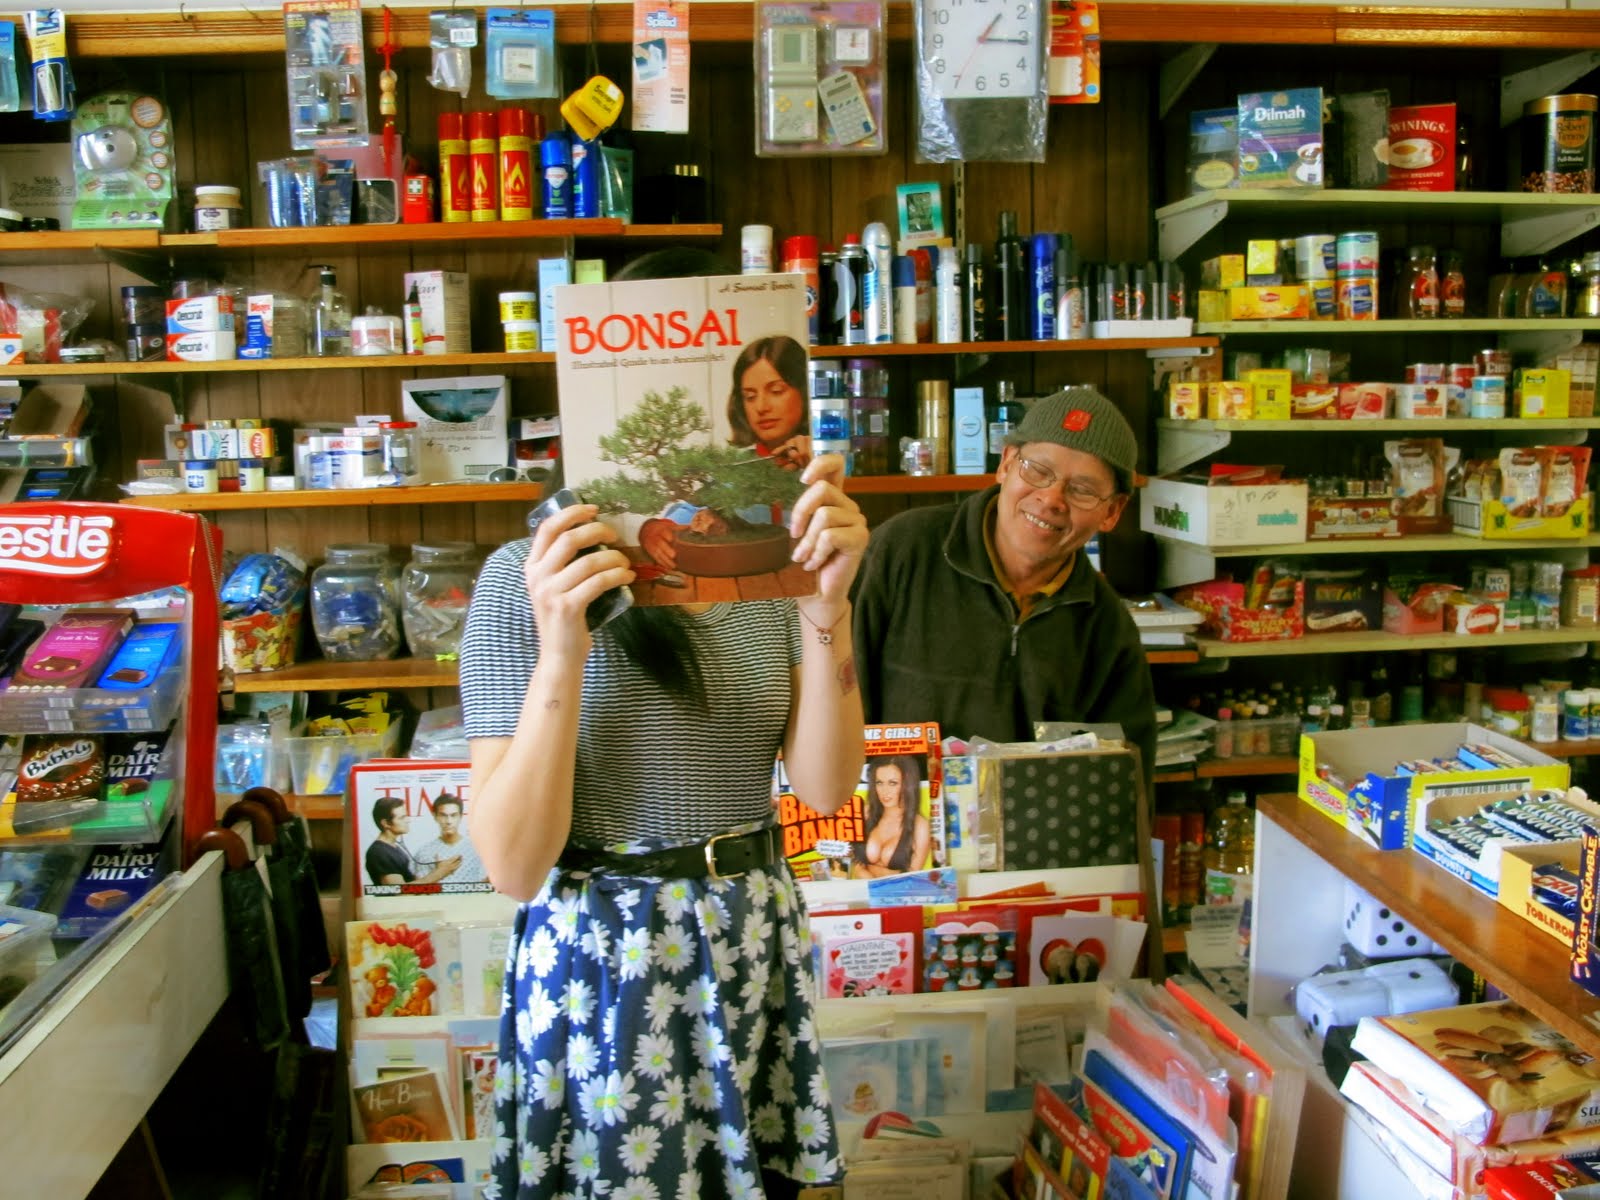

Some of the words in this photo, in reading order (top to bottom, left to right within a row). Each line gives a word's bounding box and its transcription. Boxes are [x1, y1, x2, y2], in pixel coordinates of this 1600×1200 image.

[931, 8, 950, 26] 10
[1016, 4, 1028, 21] 2
[932, 33, 944, 49] 9
[935, 58, 946, 74] 8
[1016, 56, 1027, 71] 4
[952, 74, 963, 89] 7
[975, 75, 987, 91] 6
[999, 73, 1010, 88] 5
[1254, 104, 1306, 121] Dilmah
[1388, 119, 1447, 133] WININGS
[563, 309, 743, 355] BONSAI
[884, 726, 922, 740] GIRLS
[26, 741, 94, 777] Bubbly
[374, 785, 471, 818] TIME
[784, 818, 865, 857] BANG!
[92, 853, 160, 868] DAIRY
[86, 867, 155, 880] MILK
[1580, 835, 1598, 915] CRUMBLE
[365, 885, 400, 894] TAKING
[442, 882, 494, 893] SERIOUSLY
[1525, 901, 1575, 940] TOBLERON
[1575, 914, 1591, 967] VIOLET
